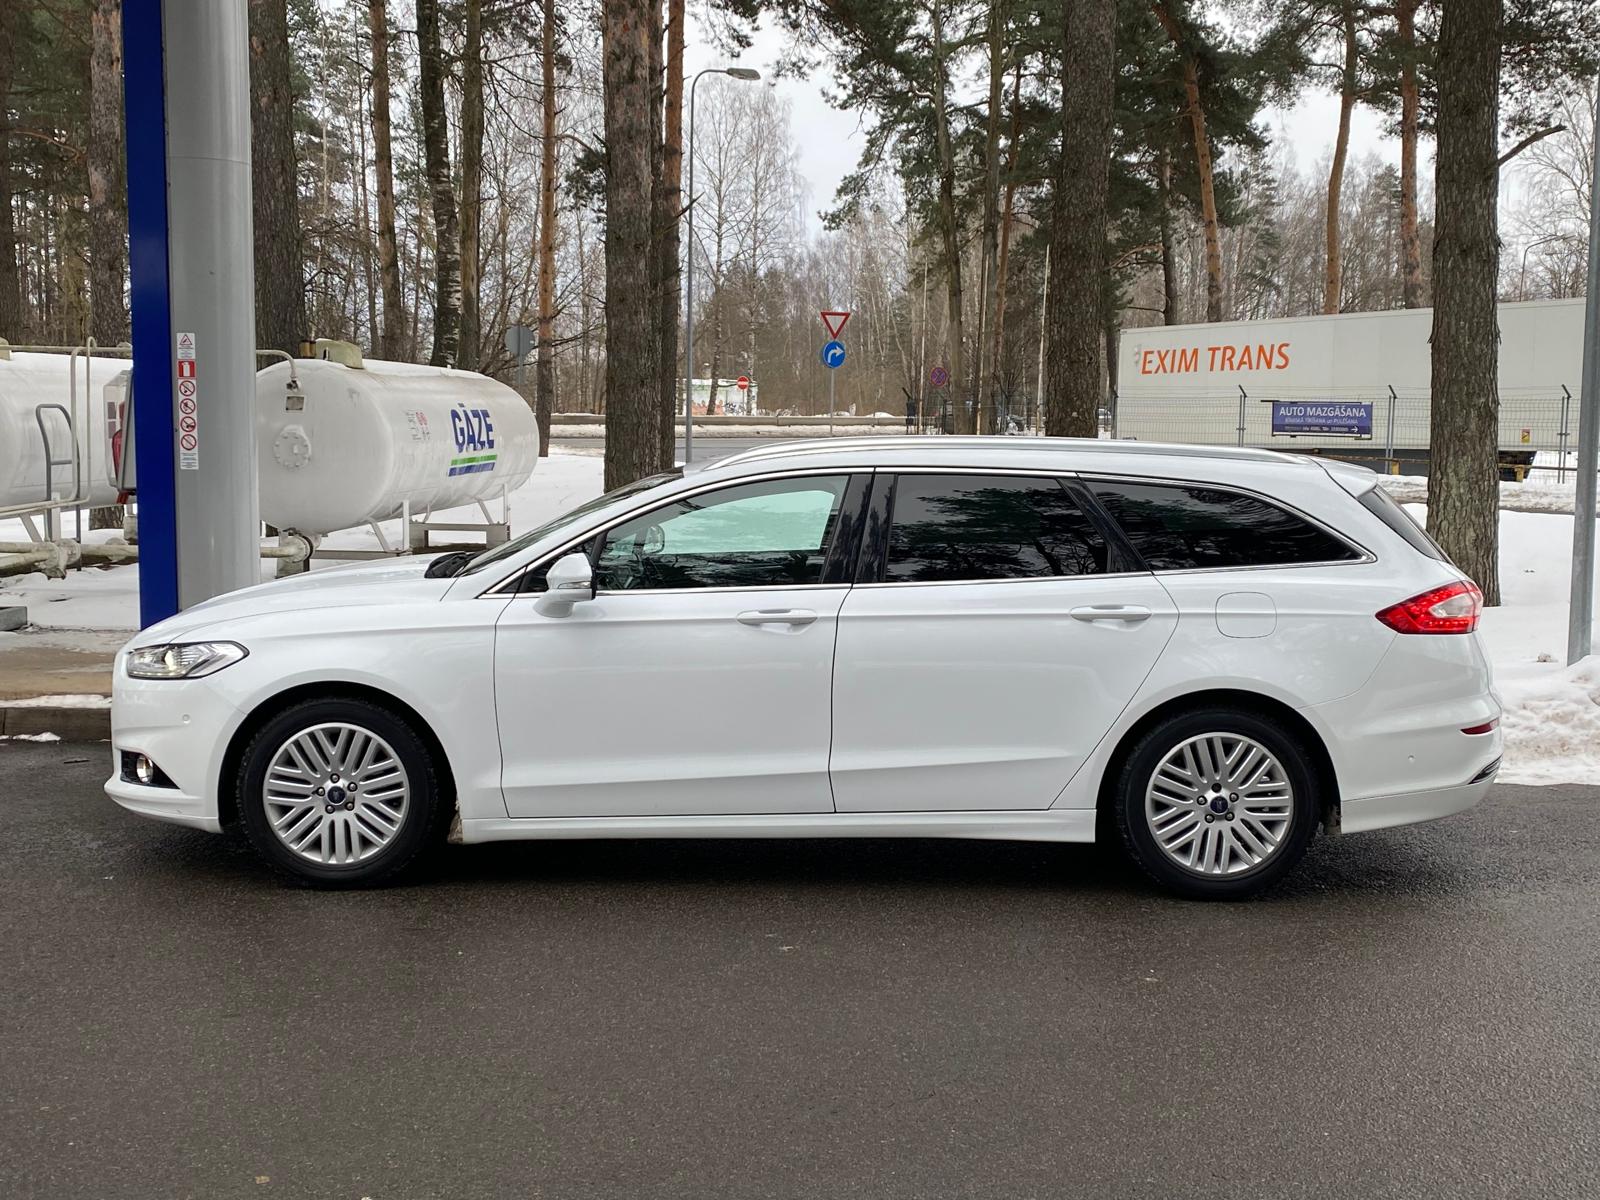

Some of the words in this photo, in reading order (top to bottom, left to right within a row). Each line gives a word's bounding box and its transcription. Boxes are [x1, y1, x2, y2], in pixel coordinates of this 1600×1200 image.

[1141, 347, 1199, 375] EXIM
[1207, 342, 1291, 372] TRANS
[450, 403, 494, 453] GĀZE
[1279, 406, 1304, 416] AUTO
[1307, 405, 1366, 418] MAZGĀŠANA
